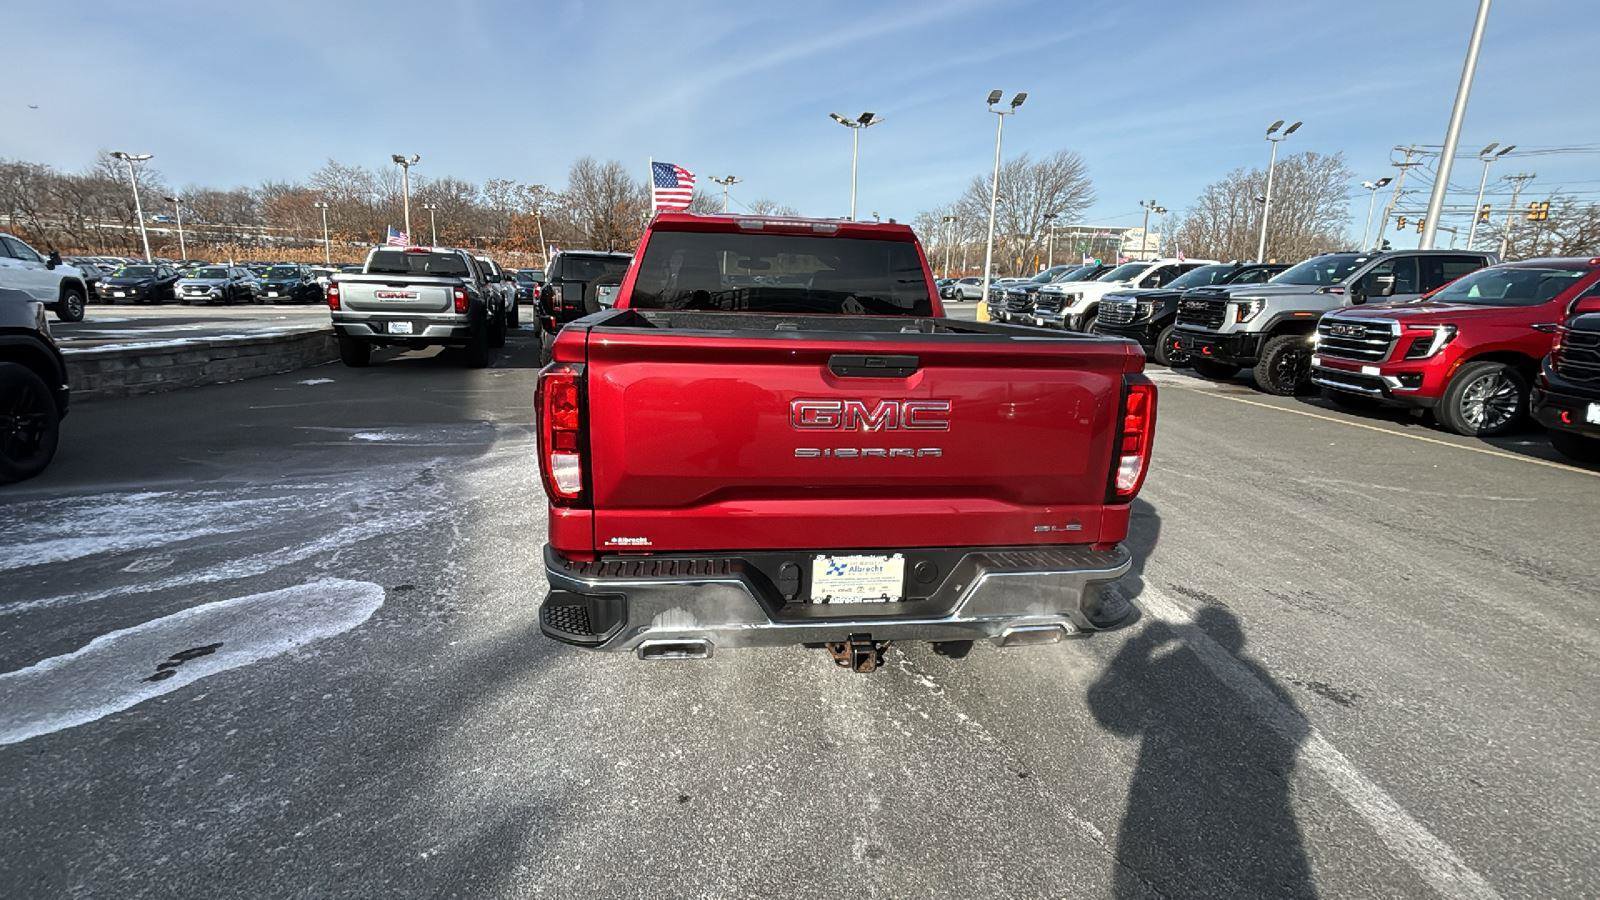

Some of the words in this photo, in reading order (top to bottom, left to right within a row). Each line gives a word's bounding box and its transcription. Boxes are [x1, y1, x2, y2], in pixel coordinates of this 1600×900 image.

[790, 399, 952, 431] GMC
[795, 447, 943, 458] SIERRA
[1033, 524, 1082, 532] SLE
[849, 565, 883, 573] Albrecht
